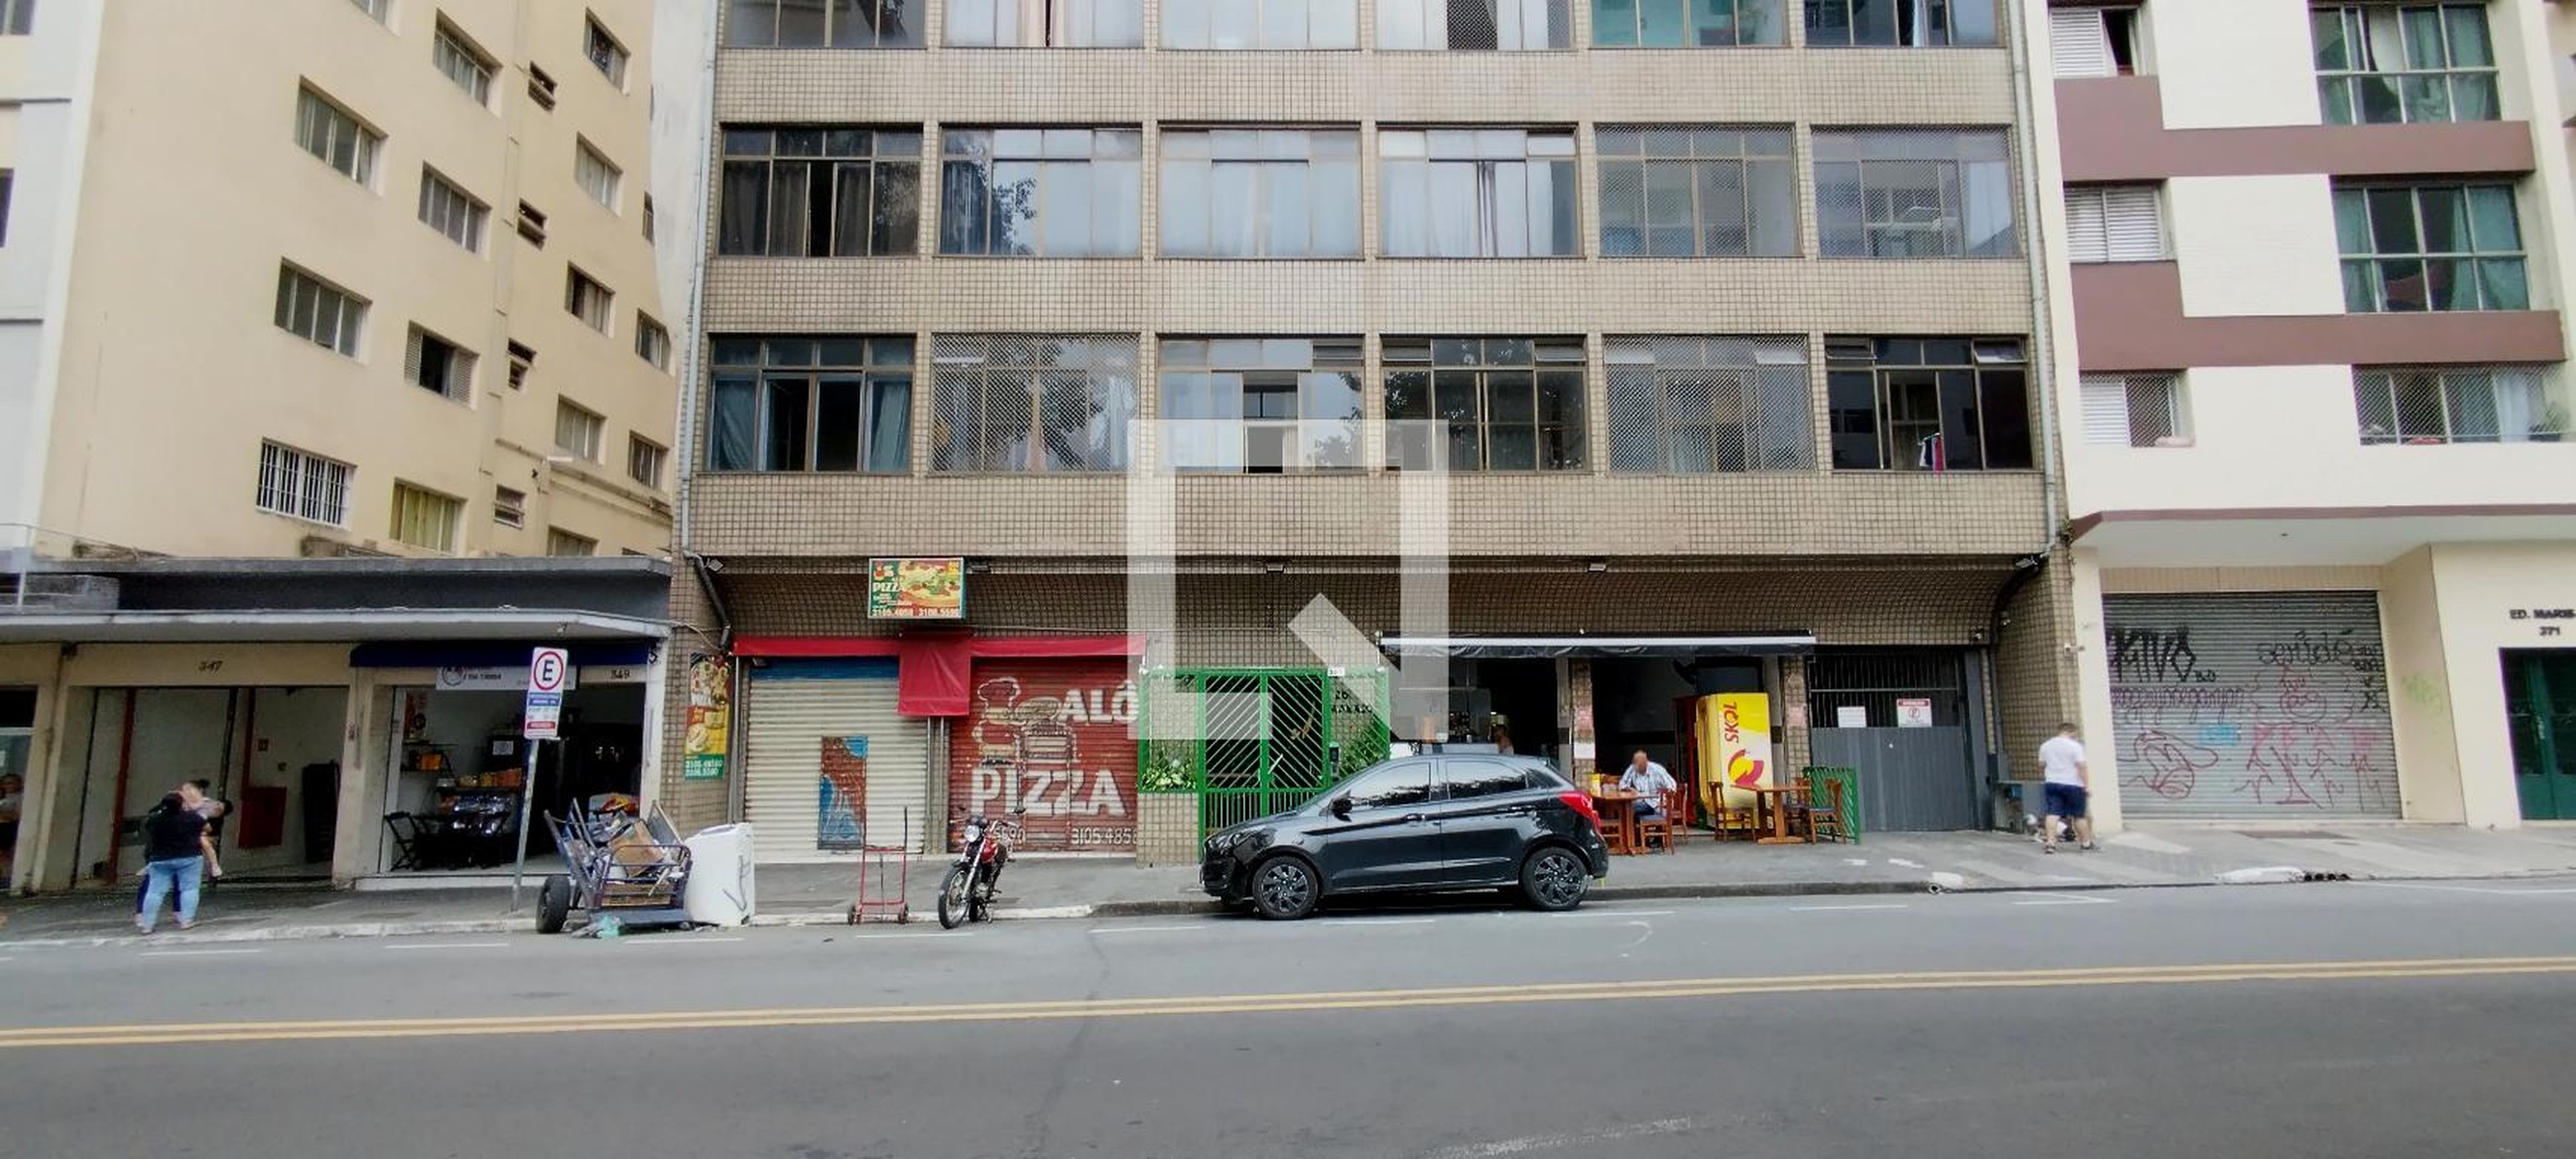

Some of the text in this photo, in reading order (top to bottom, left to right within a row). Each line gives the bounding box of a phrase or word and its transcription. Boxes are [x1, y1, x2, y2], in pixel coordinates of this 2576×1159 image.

[543, 659, 554, 681] E
[1723, 702, 1739, 743] SKOL
[971, 767, 1128, 816] PIZZA
